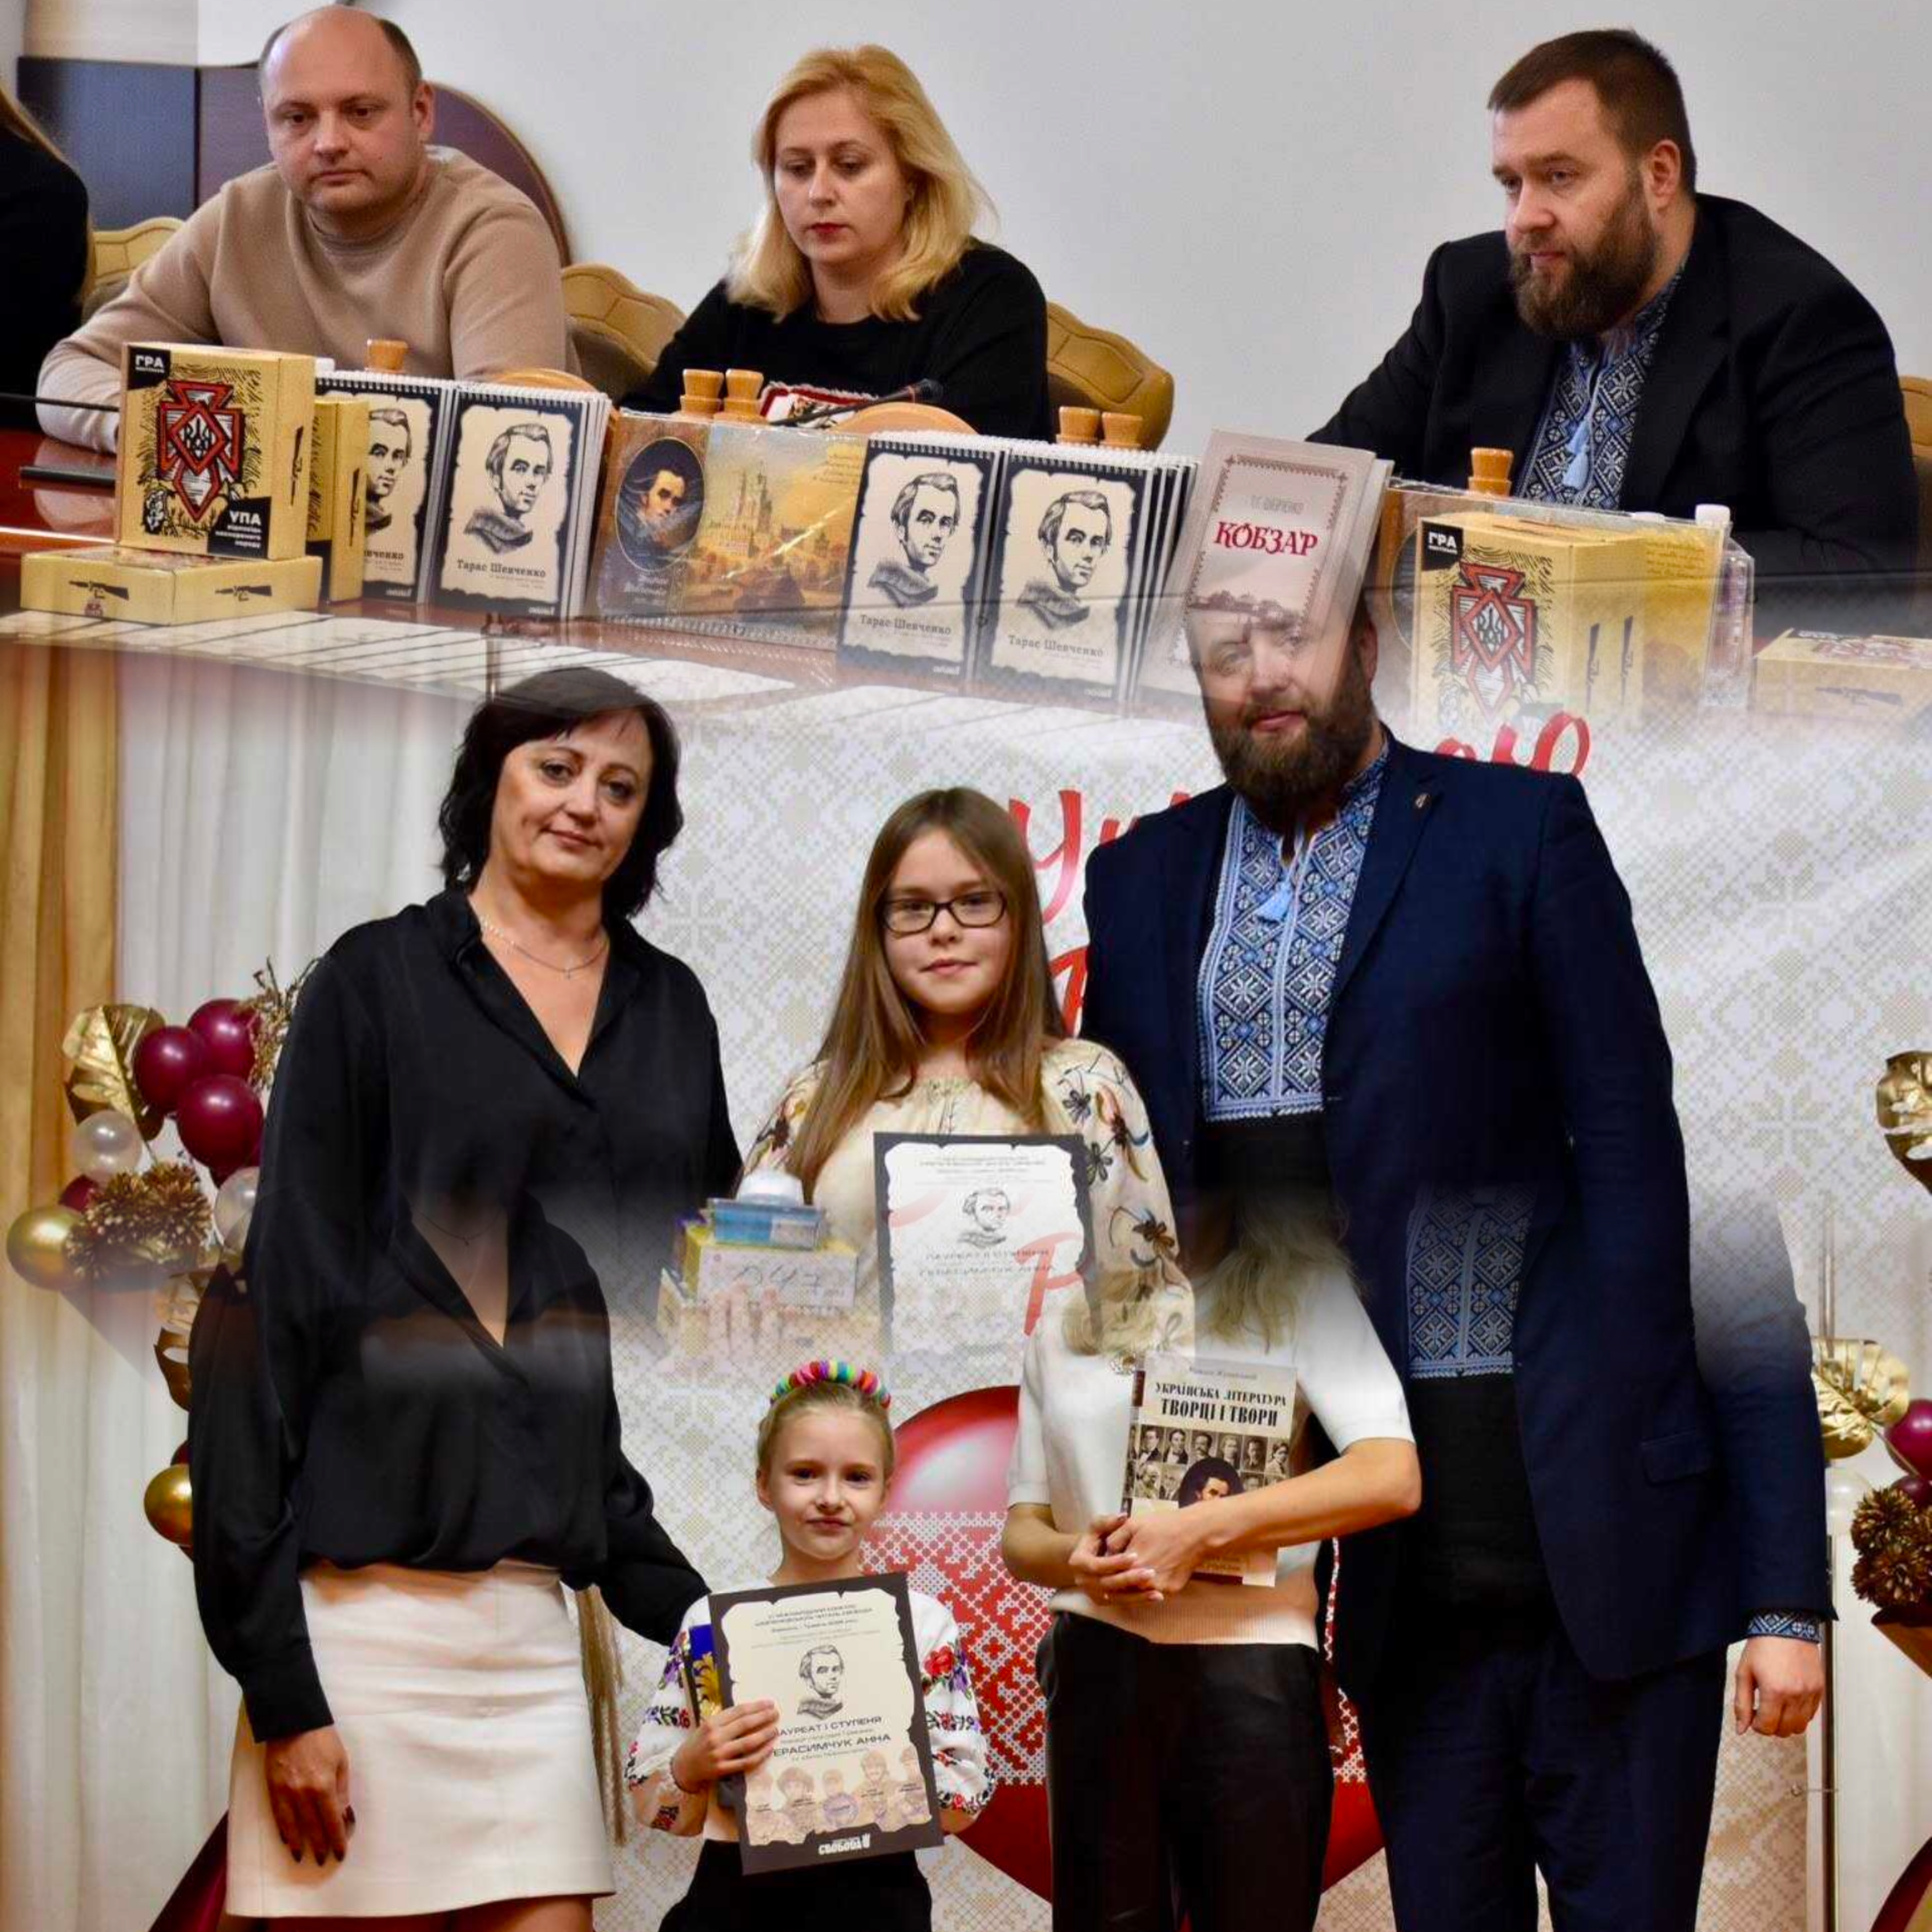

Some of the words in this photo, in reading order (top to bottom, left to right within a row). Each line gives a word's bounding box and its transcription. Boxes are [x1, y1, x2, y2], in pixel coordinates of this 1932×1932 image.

[135, 355, 163, 367] ГРА
[229, 510, 261, 525] УПА
[1214, 521, 1318, 556] КОБЗАР
[1429, 532, 1456, 548] ГРА
[457, 558, 487, 572] Тарас
[491, 563, 546, 577] Шевченко
[860, 615, 891, 628] Тарас
[894, 618, 951, 635] Шевченко
[1008, 635, 1040, 649] Тарас
[1044, 639, 1103, 657] Шевченко
[1156, 1382, 1219, 1399] УКРАЇНСЬКА
[1223, 1391, 1286, 1406] ЛІТЕРАТУРА
[1162, 1399, 1216, 1422] ТВОРЦІ
[1220, 1405, 1225, 1421] І
[1230, 1406, 1278, 1427] ТВОРИ
[830, 1716, 882, 1730] СТУПЕНЯ
[773, 1740, 852, 1757] ЕРАСИМЧУК
[857, 1734, 891, 1745] АННА
